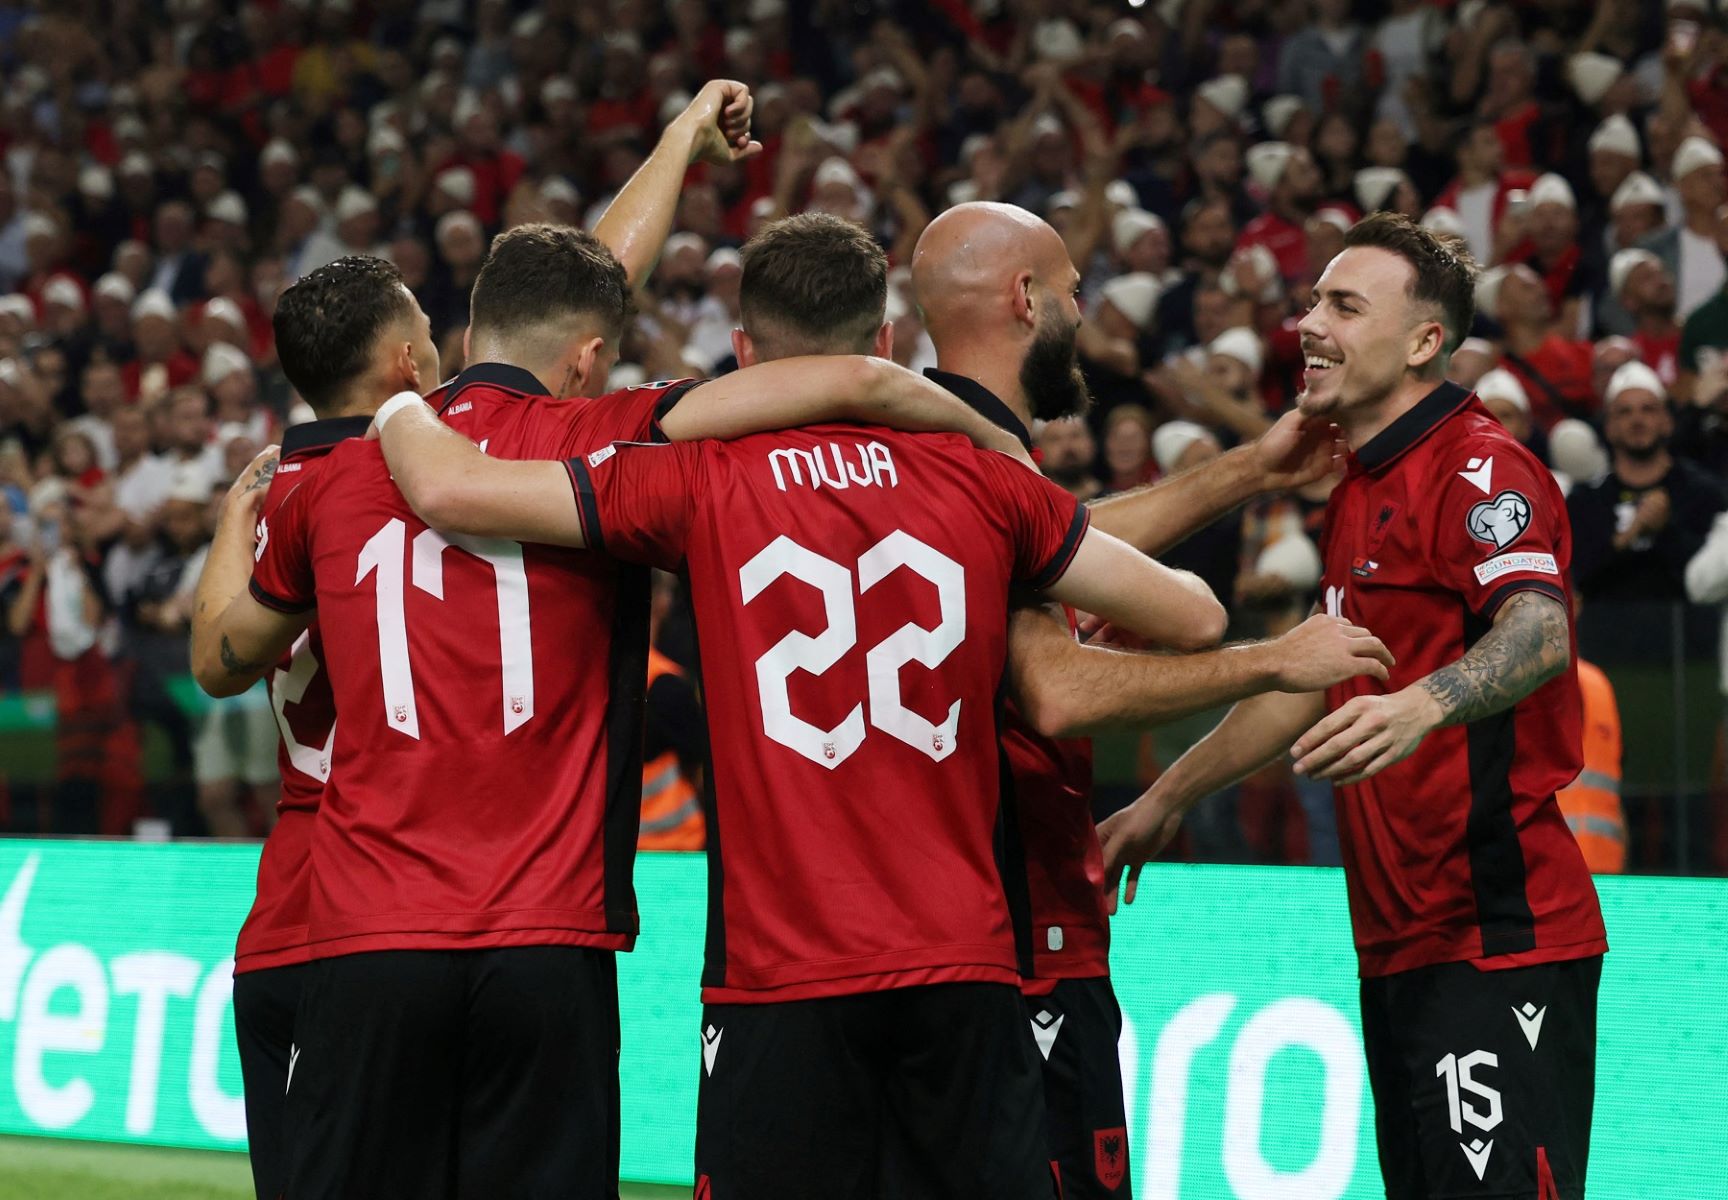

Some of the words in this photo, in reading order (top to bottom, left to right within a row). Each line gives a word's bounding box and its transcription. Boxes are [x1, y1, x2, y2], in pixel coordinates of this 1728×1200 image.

[447, 400, 473, 416] ALBANIA
[767, 440, 899, 492] MUJA
[1478, 557, 1556, 577] FOUNDATION
[354, 516, 535, 741] 17
[738, 528, 967, 771] 22
[1117, 992, 1366, 1200] ro
[1435, 1049, 1504, 1134] 15
